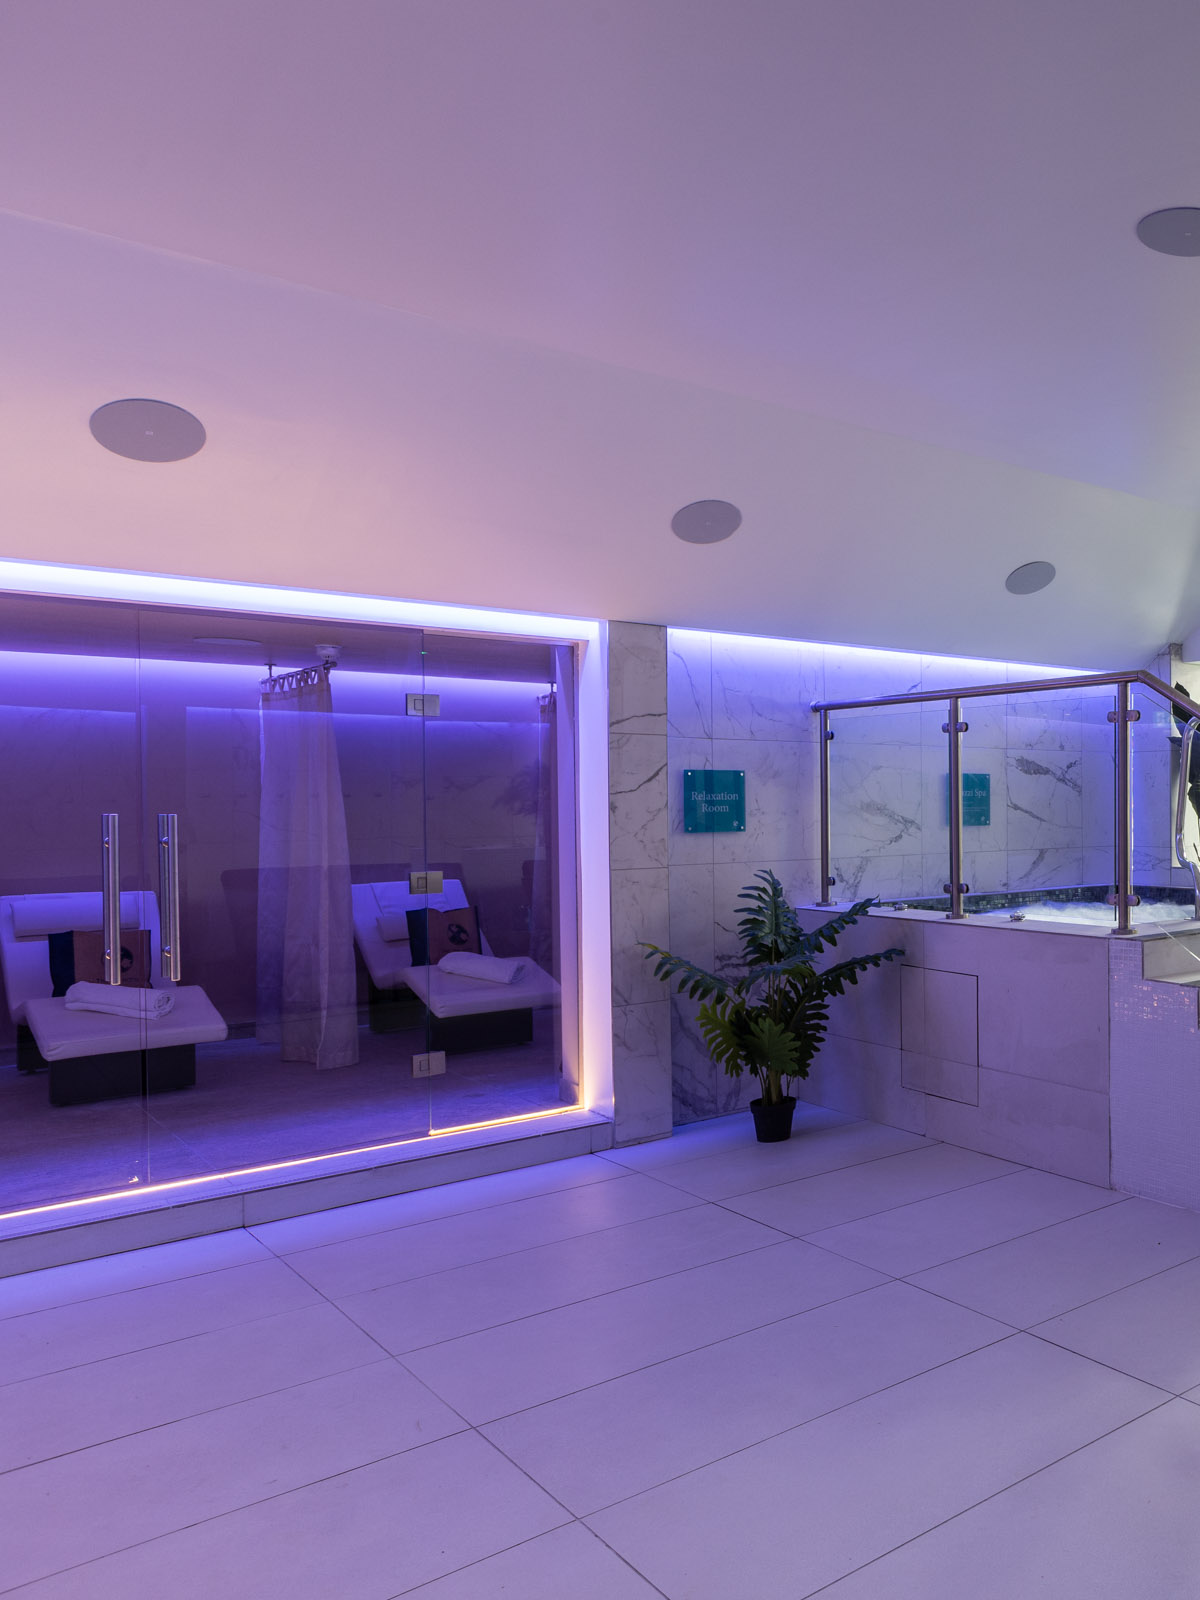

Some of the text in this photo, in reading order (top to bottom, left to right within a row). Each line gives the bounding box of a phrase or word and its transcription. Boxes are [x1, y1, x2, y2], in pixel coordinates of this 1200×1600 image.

[691, 791, 739, 801] Relaxation
[974, 788, 987, 799] Spa
[701, 803, 729, 813] Room
